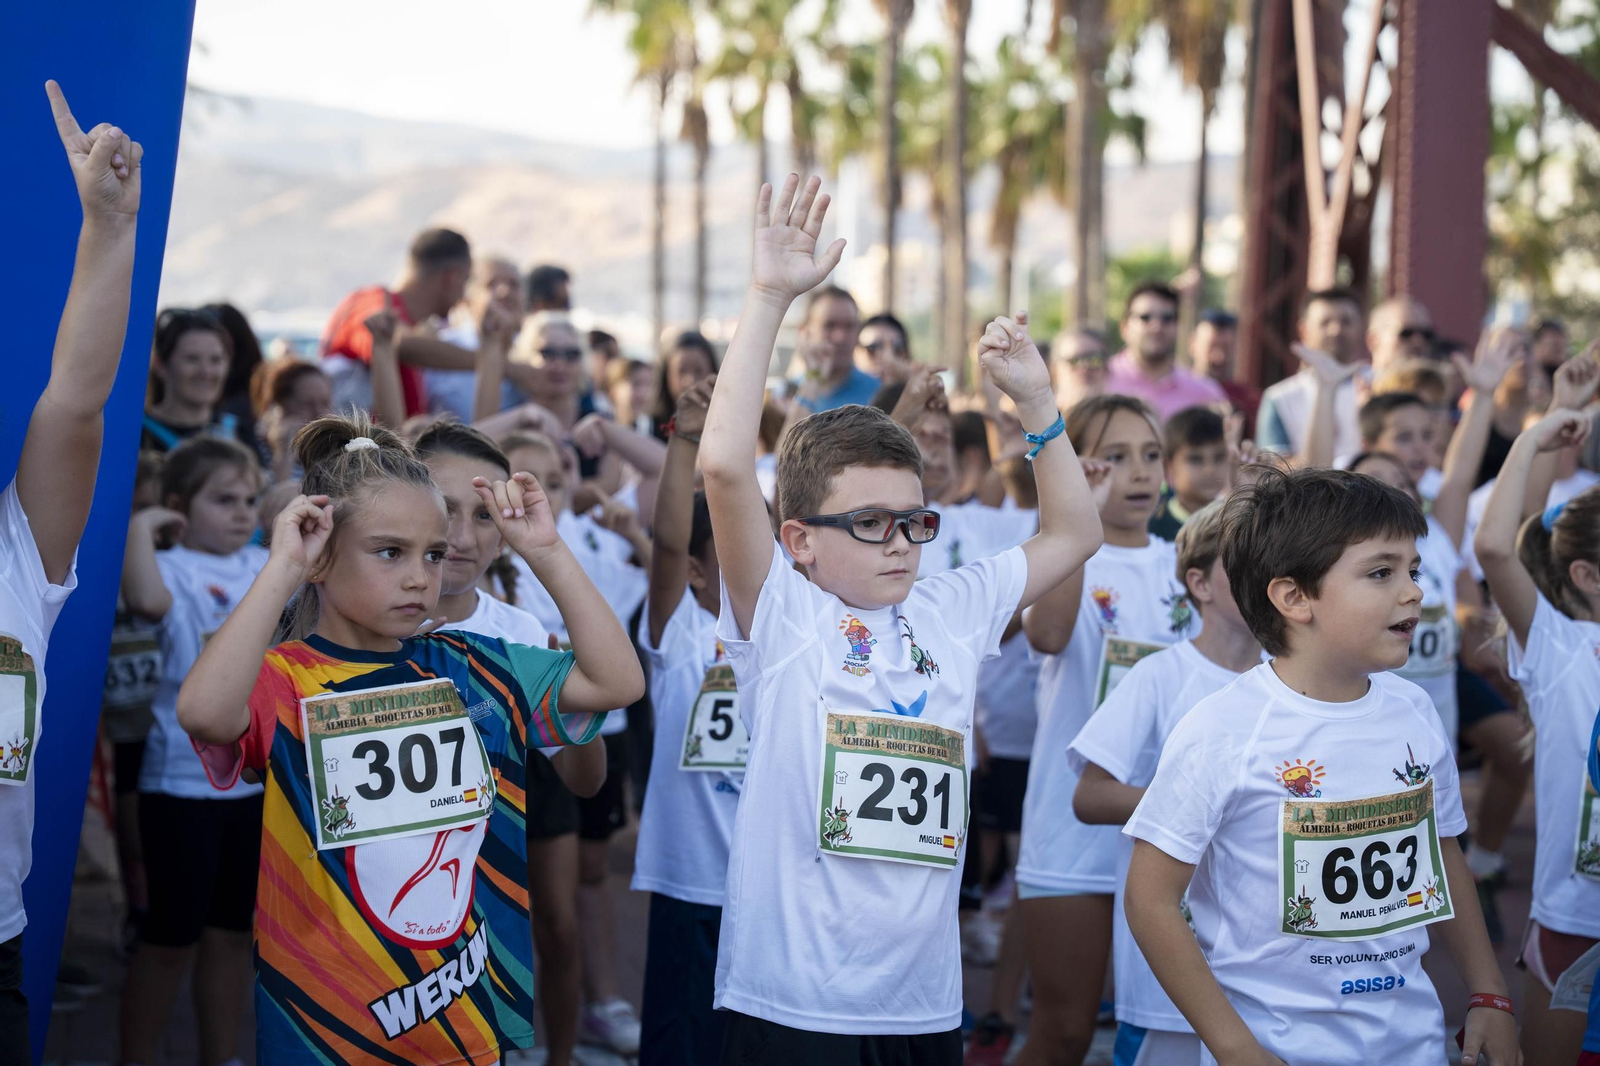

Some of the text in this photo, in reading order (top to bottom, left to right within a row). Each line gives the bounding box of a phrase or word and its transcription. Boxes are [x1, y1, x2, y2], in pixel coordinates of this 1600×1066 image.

[315, 703, 340, 721] LA
[375, 708, 424, 724] ROQUETAS
[426, 706, 437, 717] DE
[835, 719, 856, 736] LA
[886, 740, 926, 754] ROQUETAS
[927, 746, 936, 756] DE
[352, 726, 466, 801] 307
[430, 795, 464, 808] DANIELA
[856, 762, 950, 829] 231
[1292, 806, 1315, 823] LA
[1347, 819, 1386, 831] ROQUETAS
[1388, 816, 1397, 825] DE
[1399, 813, 1413, 823] MAR
[919, 834, 943, 846] MIGUEL
[1322, 835, 1418, 904] 663
[1340, 898, 1408, 920] MANUEL PEÑALVER
[1310, 942, 1415, 964] SER VOLUNTARIO SUMA
[1341, 976, 1396, 995] asisa
